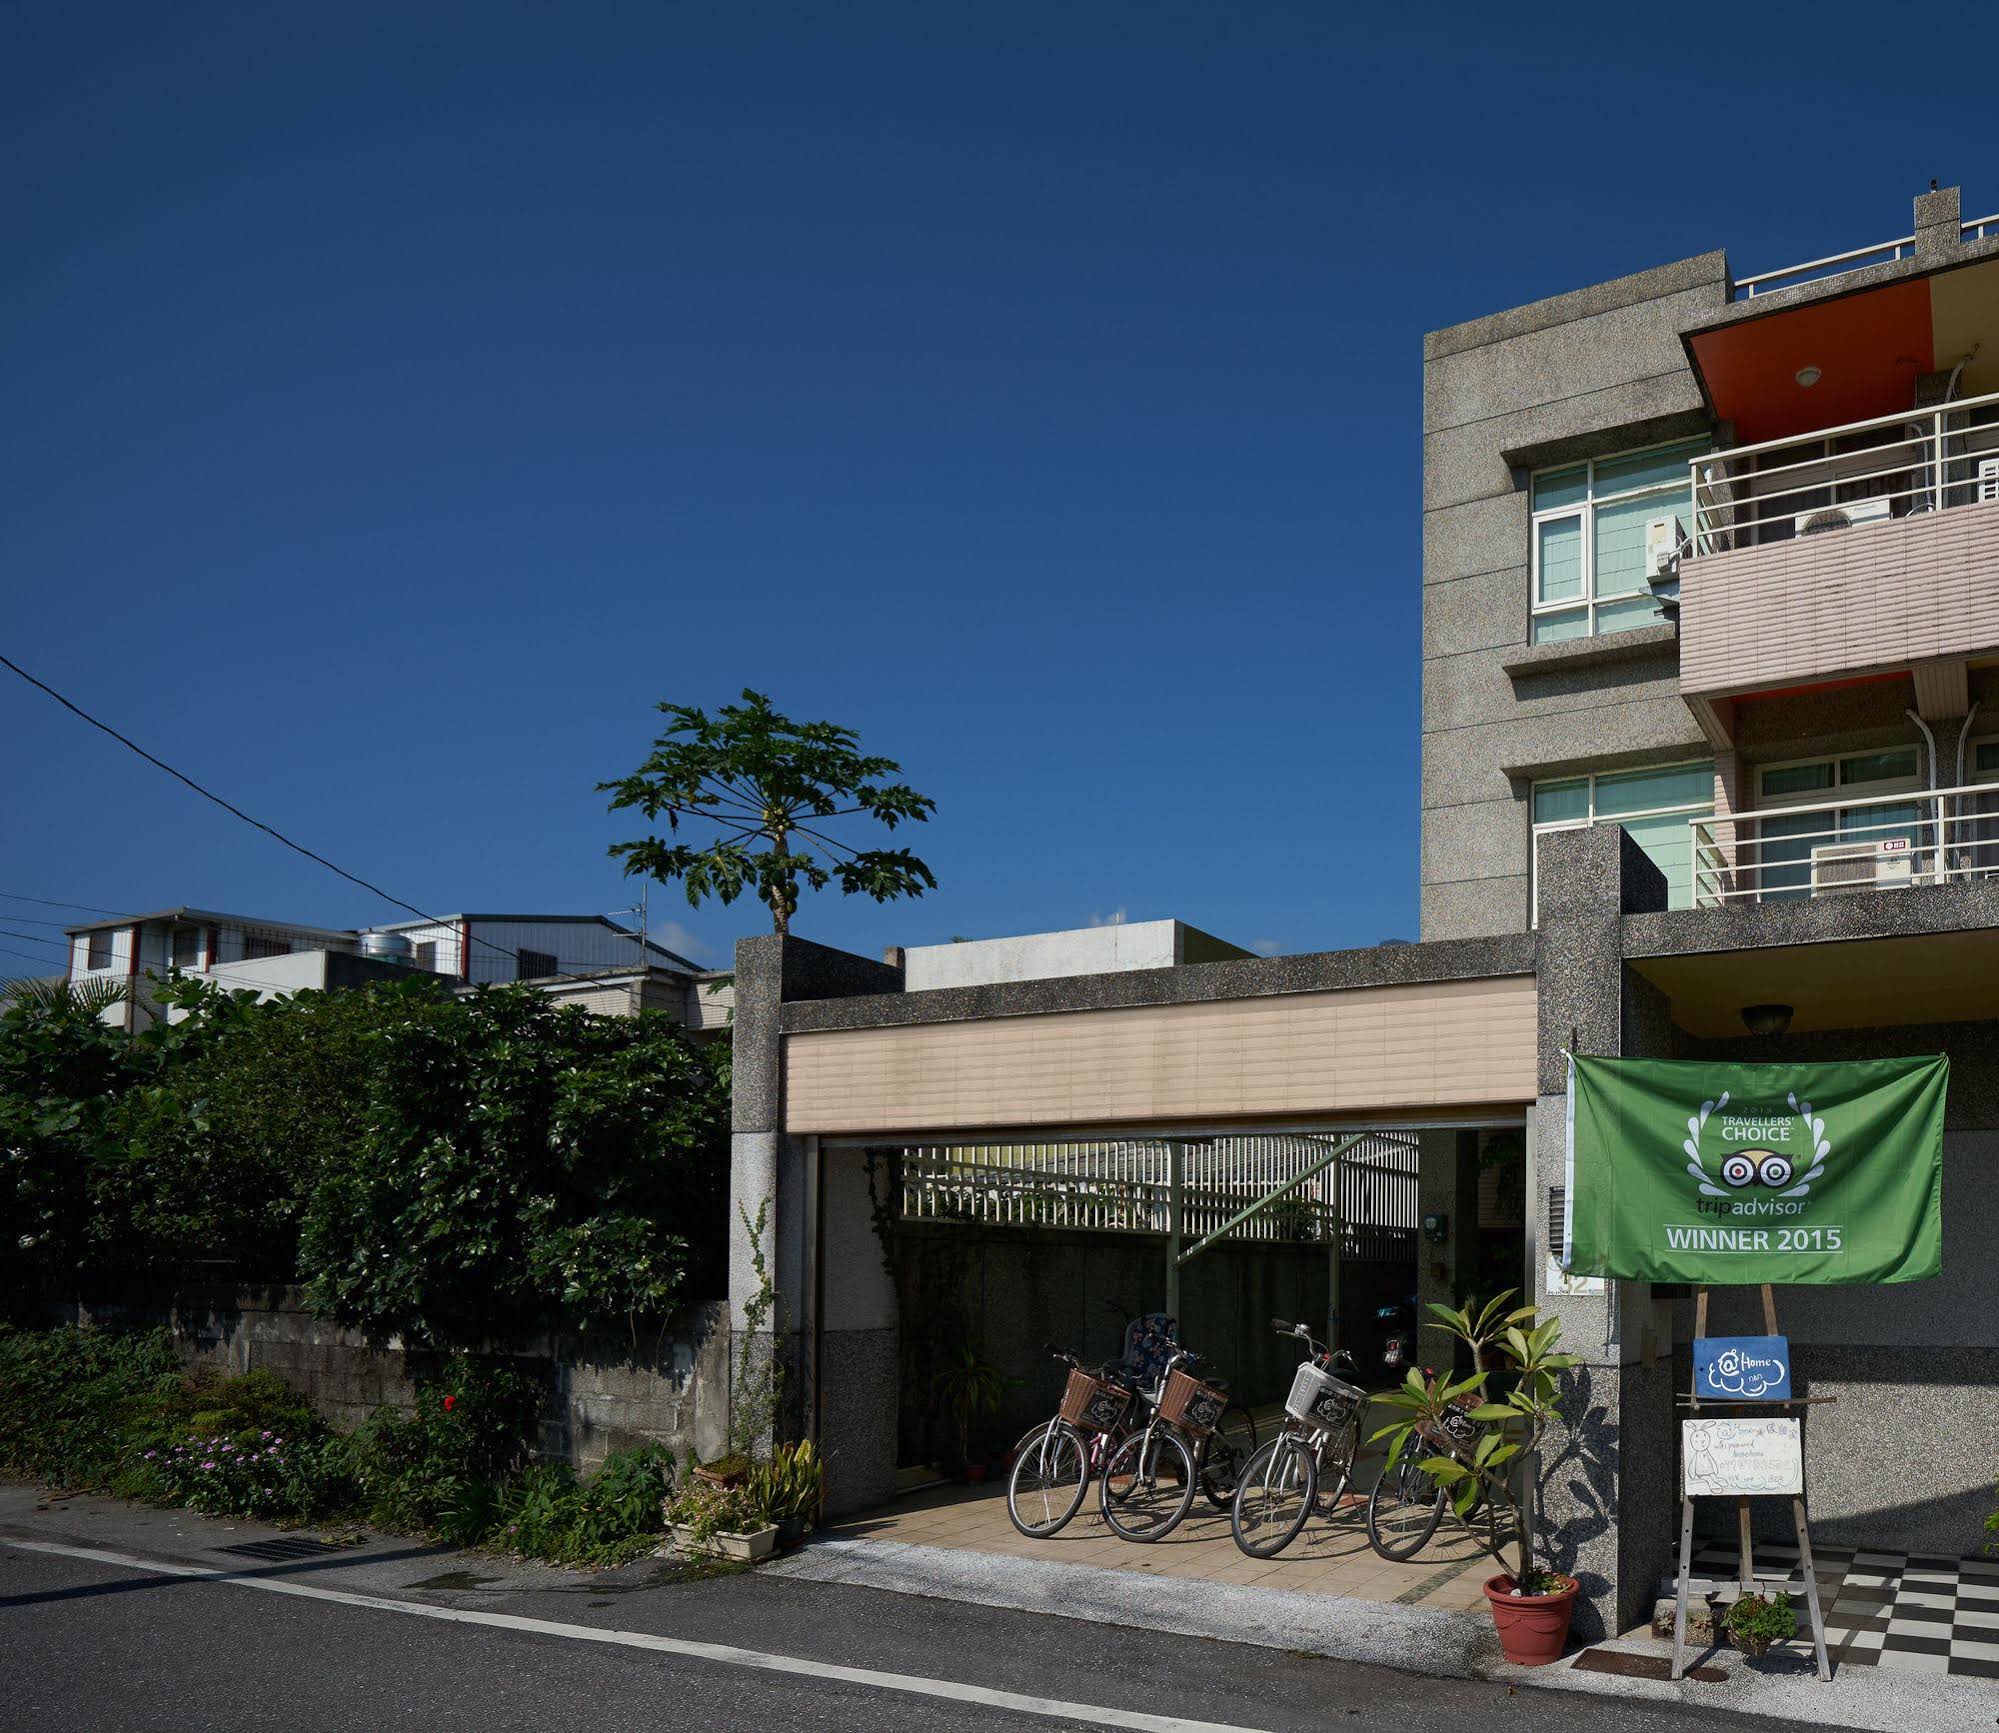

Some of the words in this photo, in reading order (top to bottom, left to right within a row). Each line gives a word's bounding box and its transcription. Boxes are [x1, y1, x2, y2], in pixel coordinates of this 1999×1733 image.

[1721, 1126, 1791, 1142] CHOICE
[1696, 1198, 1806, 1218] tripadvisor
[1666, 1227, 1769, 1250] WINNER
[1777, 1228, 1842, 1251] 2015
